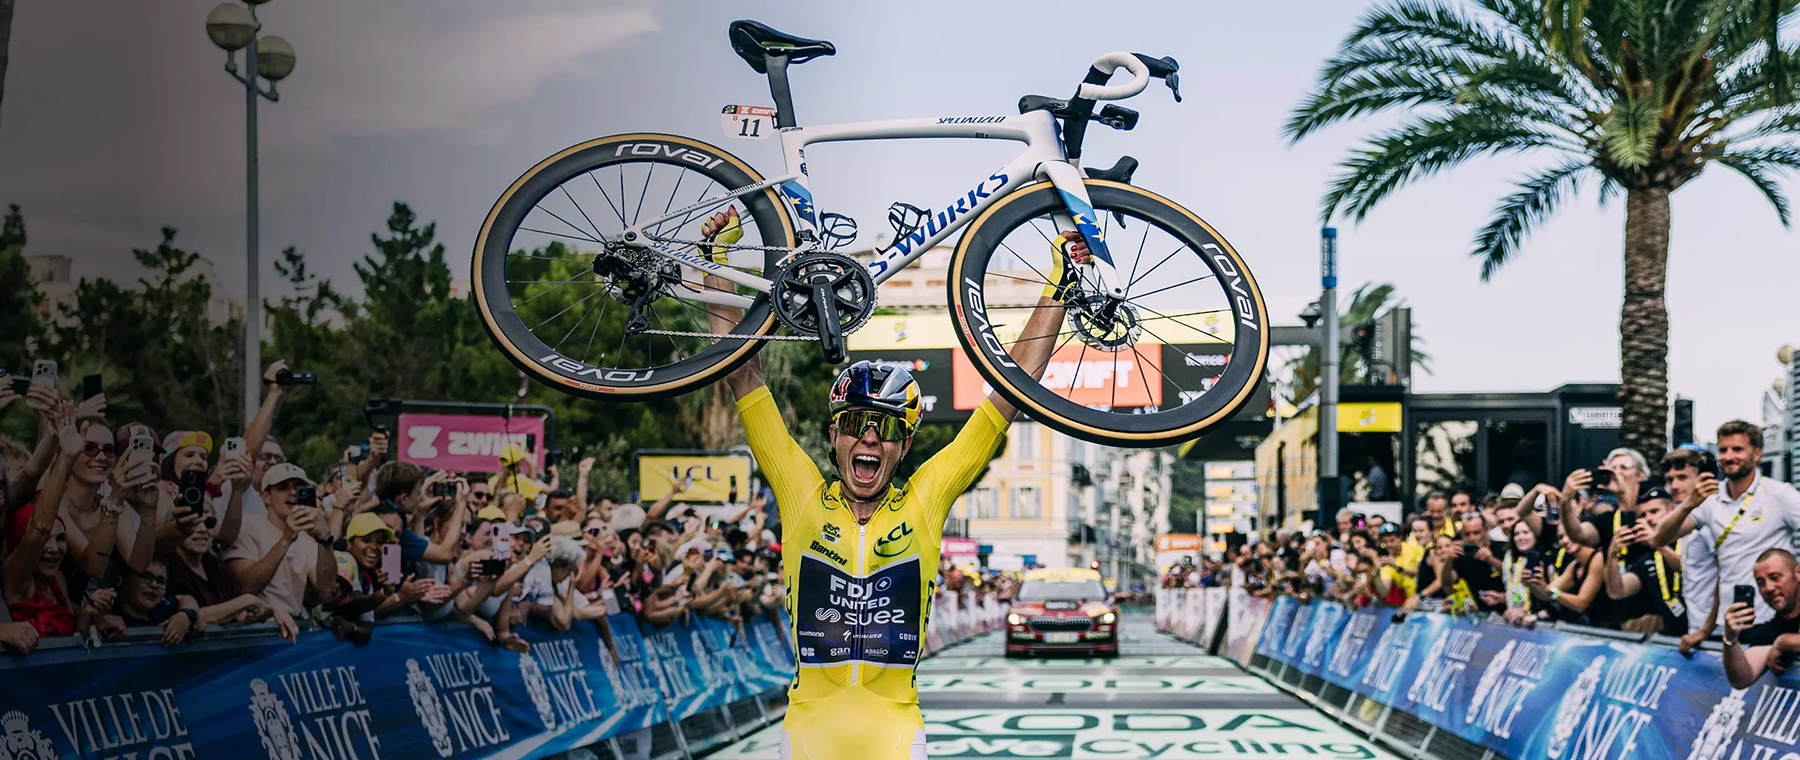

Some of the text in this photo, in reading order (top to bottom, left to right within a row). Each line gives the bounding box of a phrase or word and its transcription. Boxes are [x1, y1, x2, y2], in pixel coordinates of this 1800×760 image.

[739, 118, 760, 137] 11
[614, 143, 725, 170] roval
[868, 171, 1009, 278] S-WORKS
[1202, 243, 1258, 331] roval
[965, 277, 1018, 368] roval
[540, 354, 654, 382] roval
[810, 540, 848, 566] Santini
[878, 522, 913, 547] LCL
[829, 594, 891, 610] UNITED
[830, 574, 873, 600] FDJ
[425, 650, 491, 690] VILLE DE
[278, 665, 366, 716] VILLE DE
[547, 669, 602, 729] NICE
[48, 688, 188, 756] VILLE DE
[300, 708, 381, 760] NICE
[443, 686, 511, 752] NICE
[922, 713, 1326, 732] KODA
[1745, 684, 1800, 746] VILL
[1080, 738, 1378, 760] Cycling
